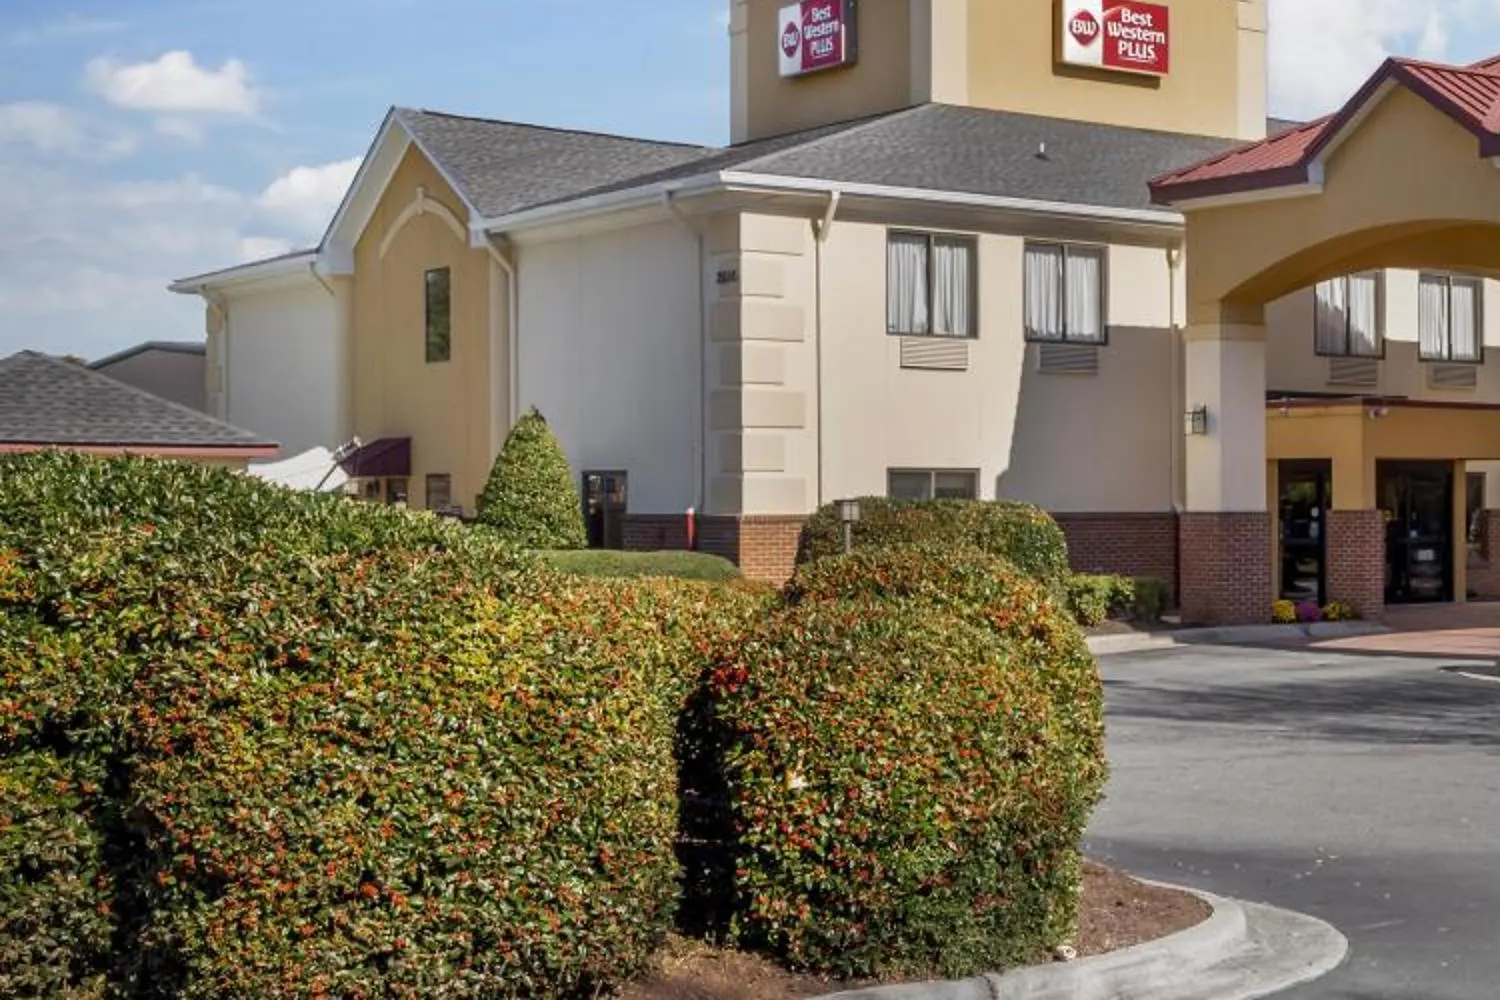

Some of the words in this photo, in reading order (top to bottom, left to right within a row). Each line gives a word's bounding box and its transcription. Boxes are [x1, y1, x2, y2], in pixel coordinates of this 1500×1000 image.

[811, 5, 831, 22] Best
[1121, 8, 1153, 27] Best
[803, 20, 839, 40] Western
[1071, 19, 1097, 36] BW
[1107, 22, 1165, 44] Western
[1118, 41, 1155, 59] PLUS
